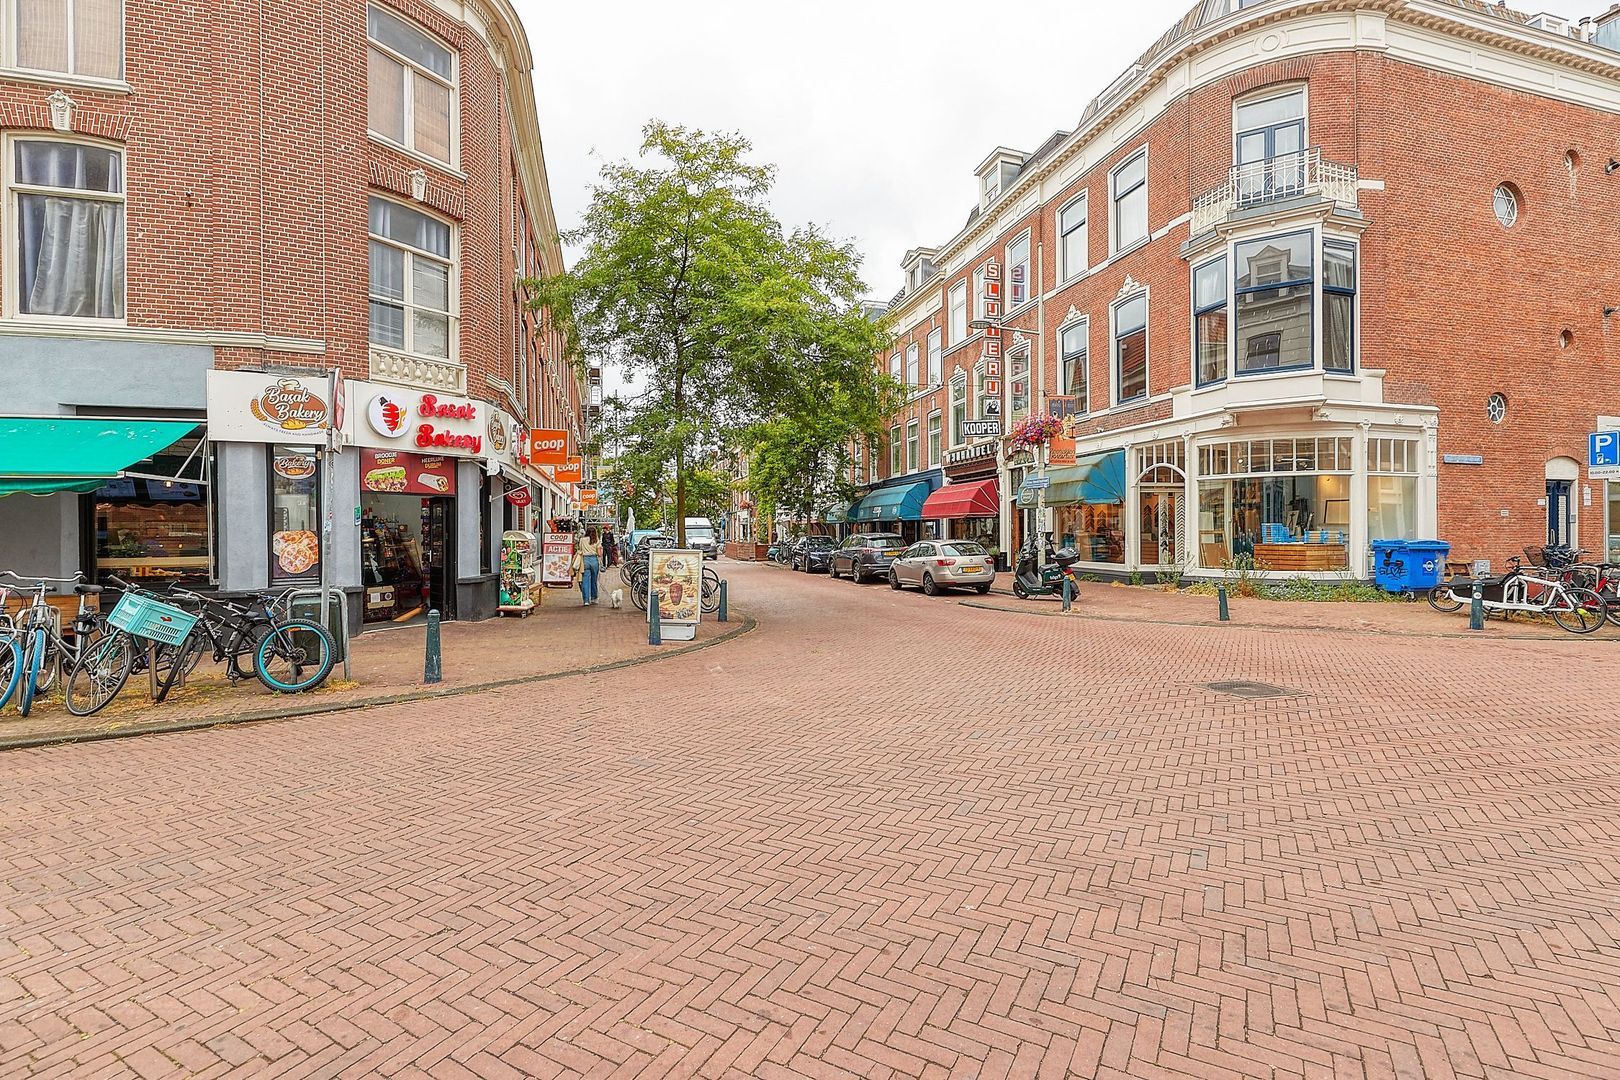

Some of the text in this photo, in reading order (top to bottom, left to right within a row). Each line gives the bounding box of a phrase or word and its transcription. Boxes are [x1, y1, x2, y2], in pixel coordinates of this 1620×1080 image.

[275, 403, 324, 421] Bakery
[963, 422, 999, 435] KOOPER
[415, 423, 482, 454] Bakery
[534, 439, 565, 451] coop
[1595, 434, 1613, 453] P
[557, 463, 580, 472] coop
[550, 534, 569, 542] coop
